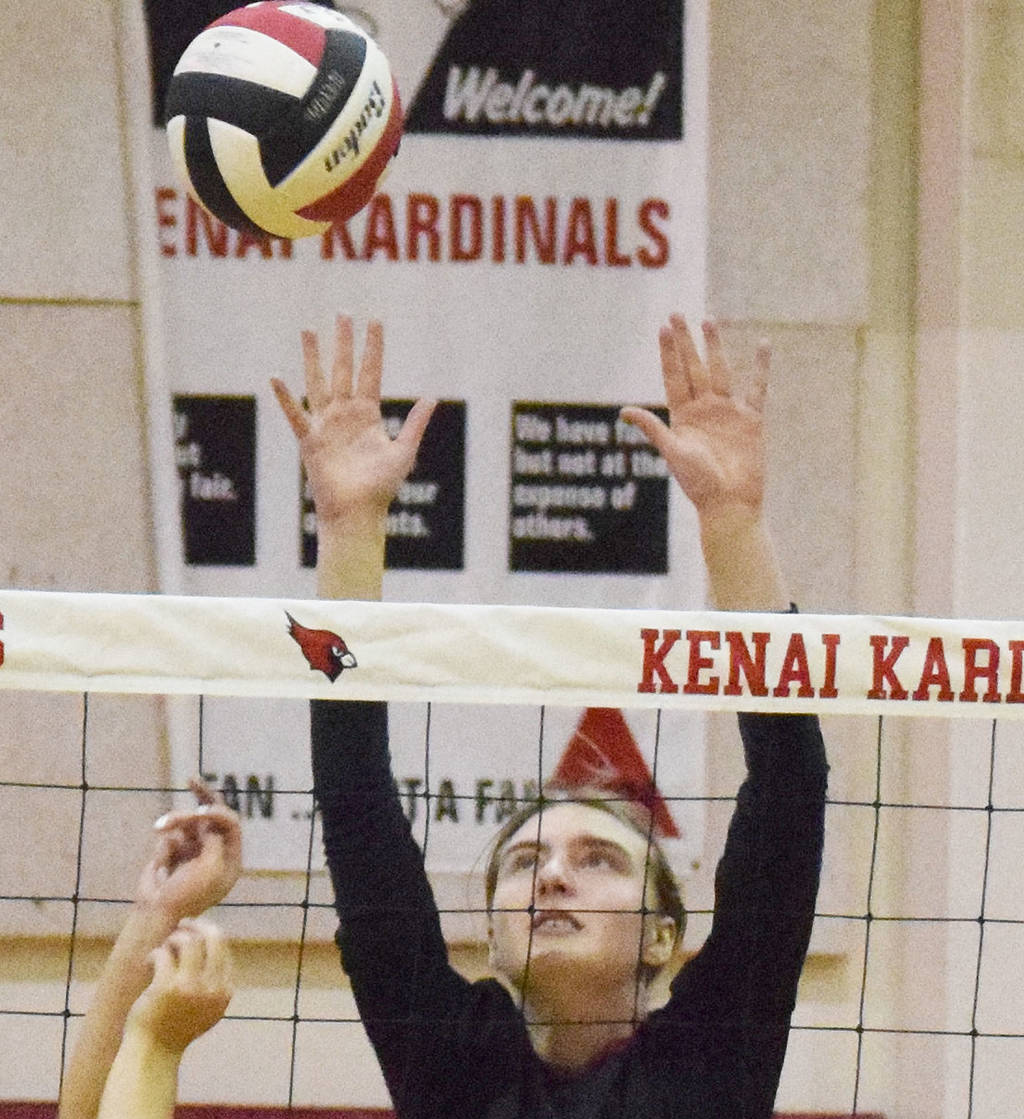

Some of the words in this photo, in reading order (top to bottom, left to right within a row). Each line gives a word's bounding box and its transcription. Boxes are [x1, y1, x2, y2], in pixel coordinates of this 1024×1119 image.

[443, 66, 666, 128] Welcome!
[556, 413, 610, 442] have
[611, 481, 637, 510] of
[513, 511, 595, 541] others.
[637, 628, 841, 699] KENAI
